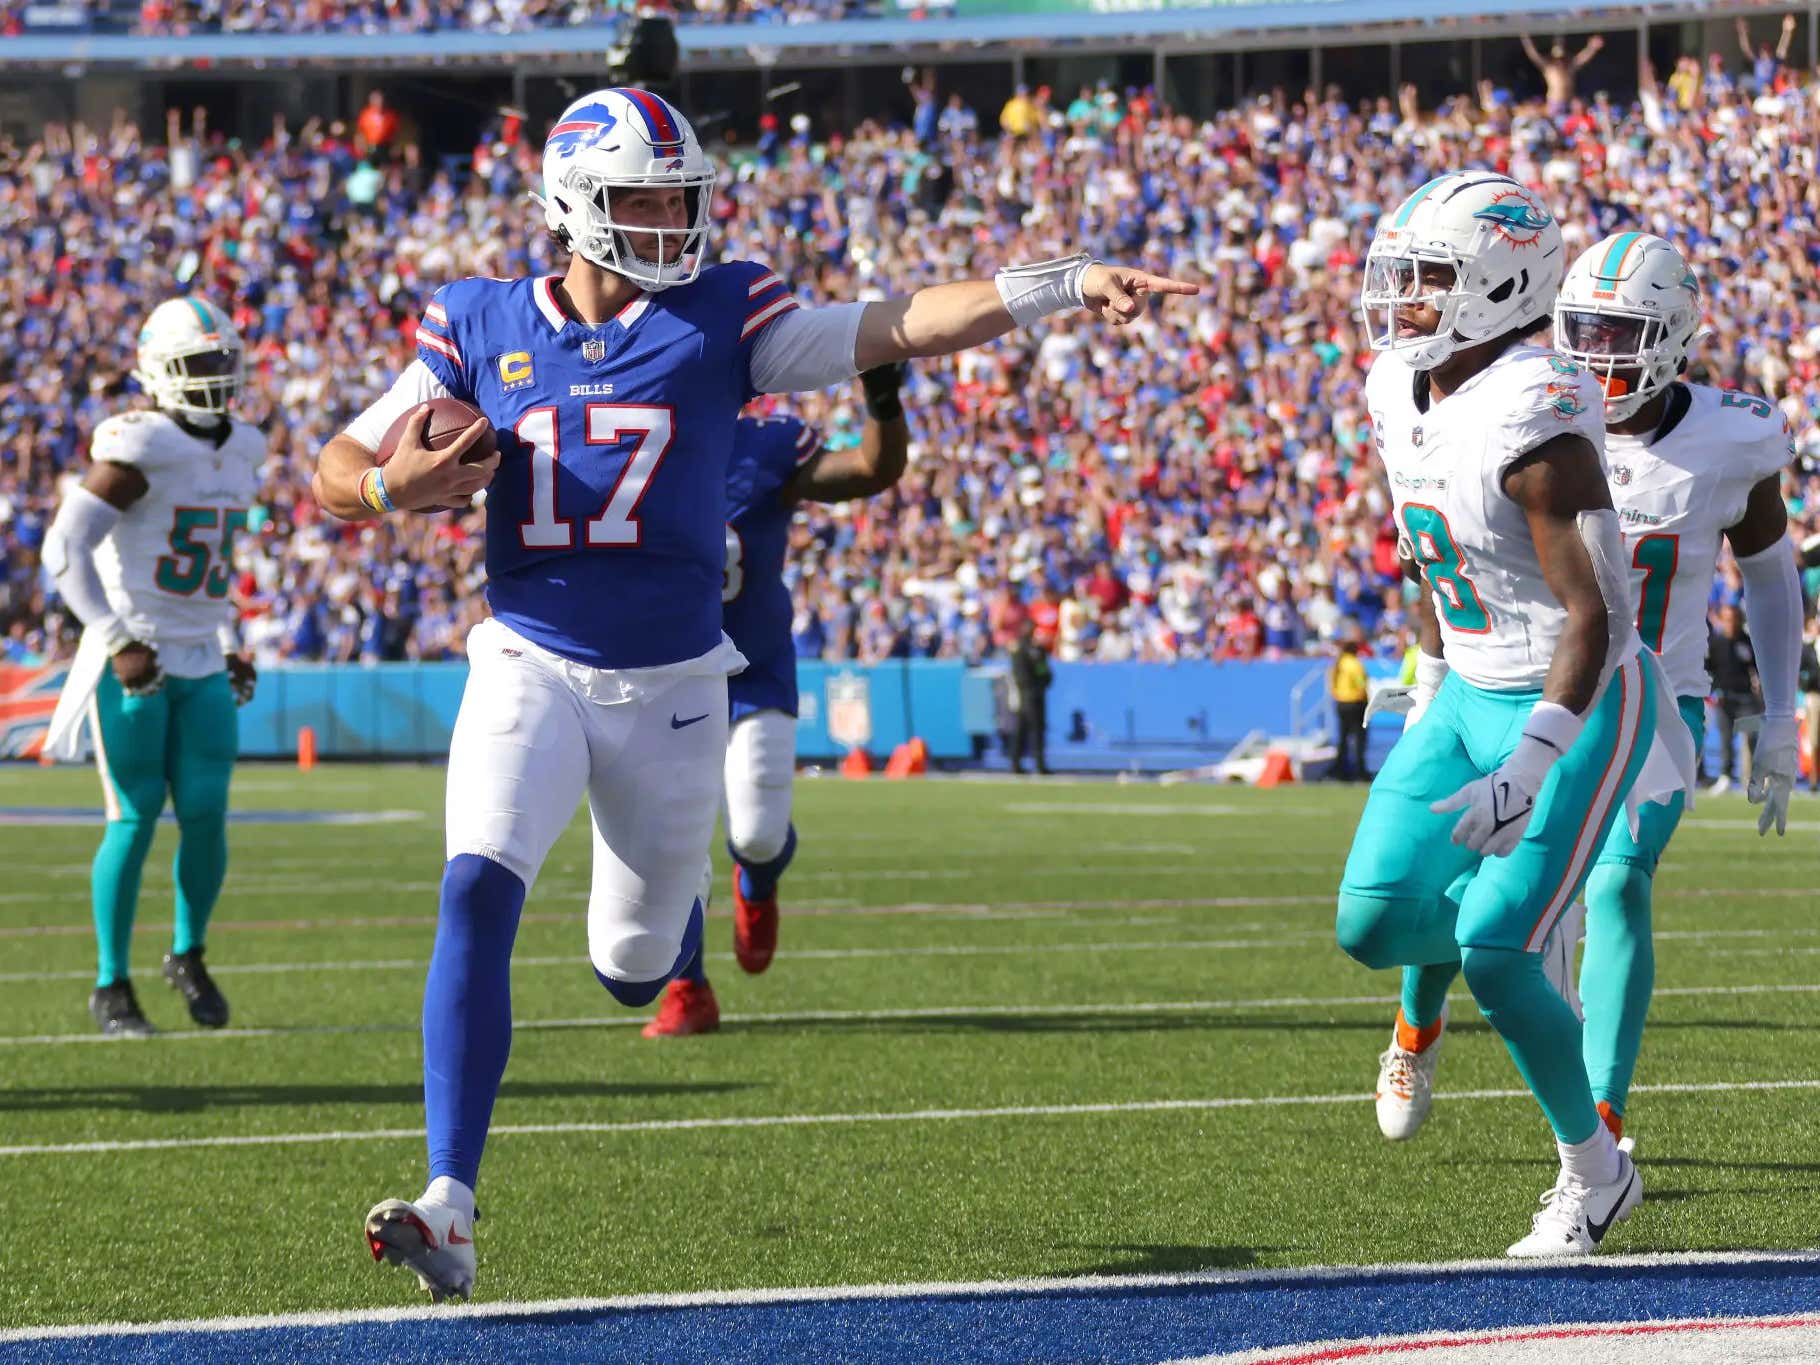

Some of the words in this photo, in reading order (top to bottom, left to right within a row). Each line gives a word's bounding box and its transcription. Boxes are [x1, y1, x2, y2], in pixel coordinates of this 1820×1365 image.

[499, 351, 532, 383] C
[569, 384, 613, 396] BILLS
[515, 403, 676, 550] 17
[154, 506, 248, 598] 55
[1400, 501, 1492, 635] 8
[1620, 532, 1680, 656] 1
